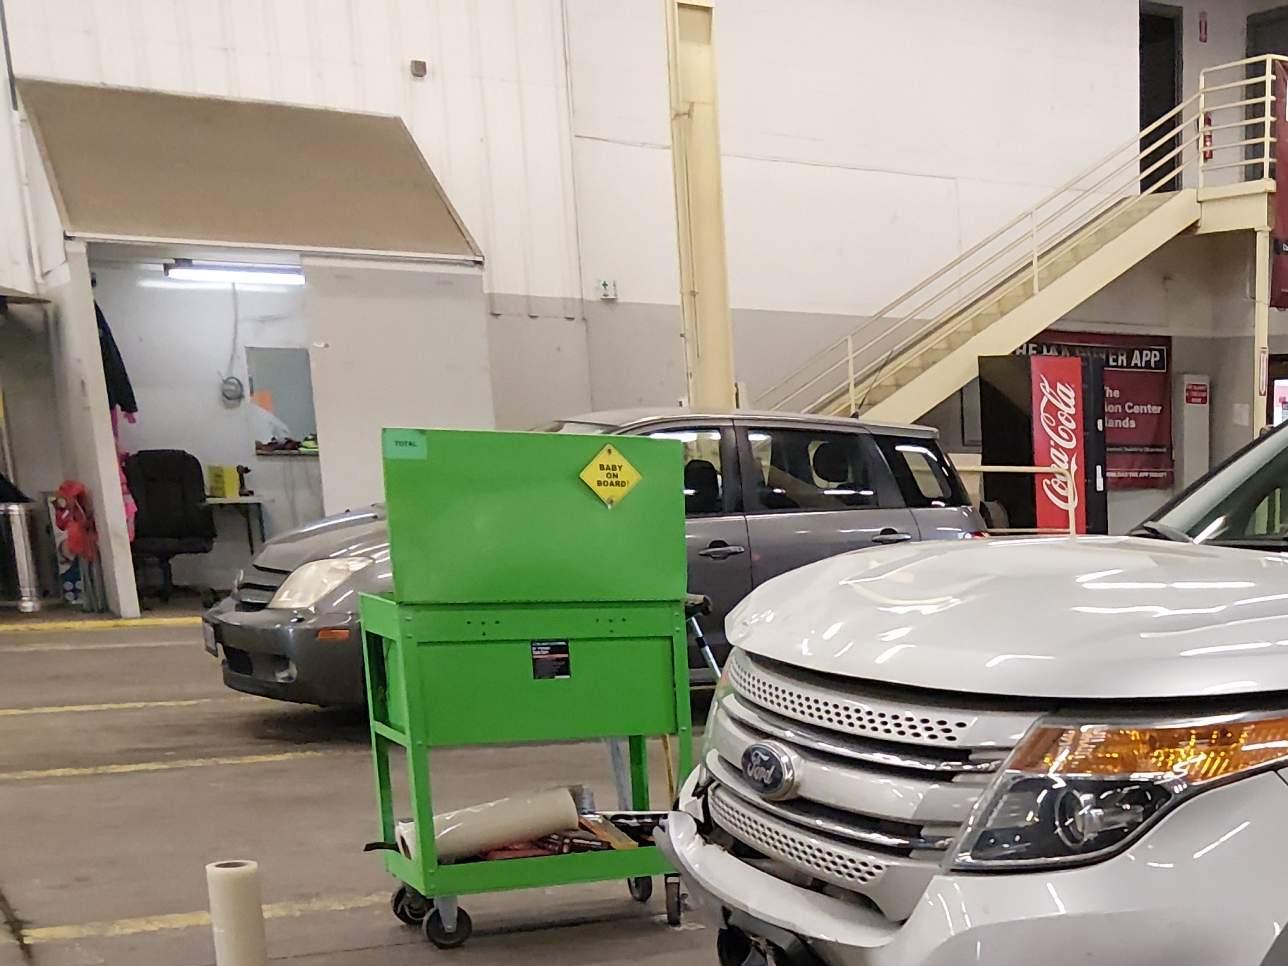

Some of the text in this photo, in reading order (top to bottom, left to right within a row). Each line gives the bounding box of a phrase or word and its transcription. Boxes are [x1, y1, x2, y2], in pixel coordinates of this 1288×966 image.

[1131, 350, 1160, 369] APP
[1125, 402, 1162, 414] Center
[1040, 373, 1078, 510] Coca-Cola
[599, 463, 623, 472] BABY
[747, 750, 776, 785] Ford
